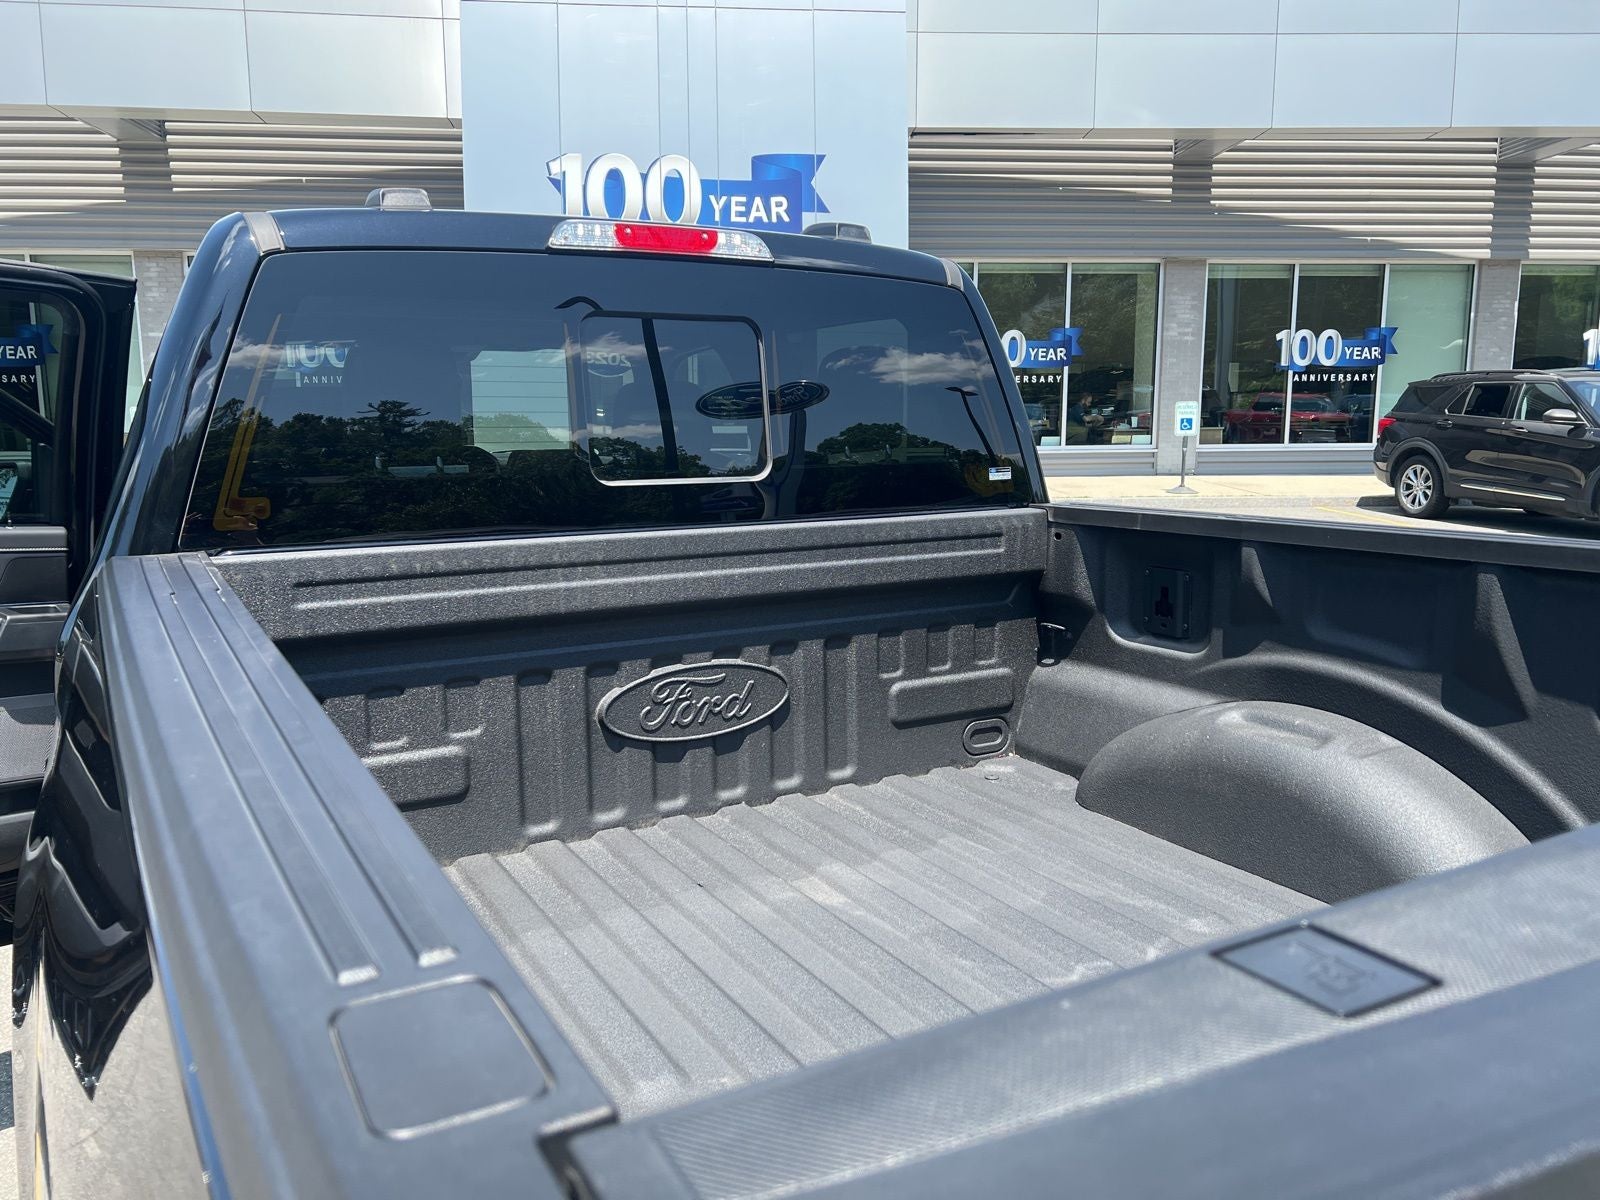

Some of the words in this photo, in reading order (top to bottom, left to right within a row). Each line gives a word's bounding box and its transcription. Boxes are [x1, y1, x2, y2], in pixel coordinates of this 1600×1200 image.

[548, 152, 702, 225] 100
[709, 195, 790, 223] YEAR
[1029, 347, 1067, 361] YEAR
[1275, 328, 1343, 367] 100
[1344, 346, 1381, 360] YEAR
[1583, 328, 1600, 366] 1
[1293, 373, 1376, 382] ANNIVERSARY
[640, 672, 755, 732] Ford
